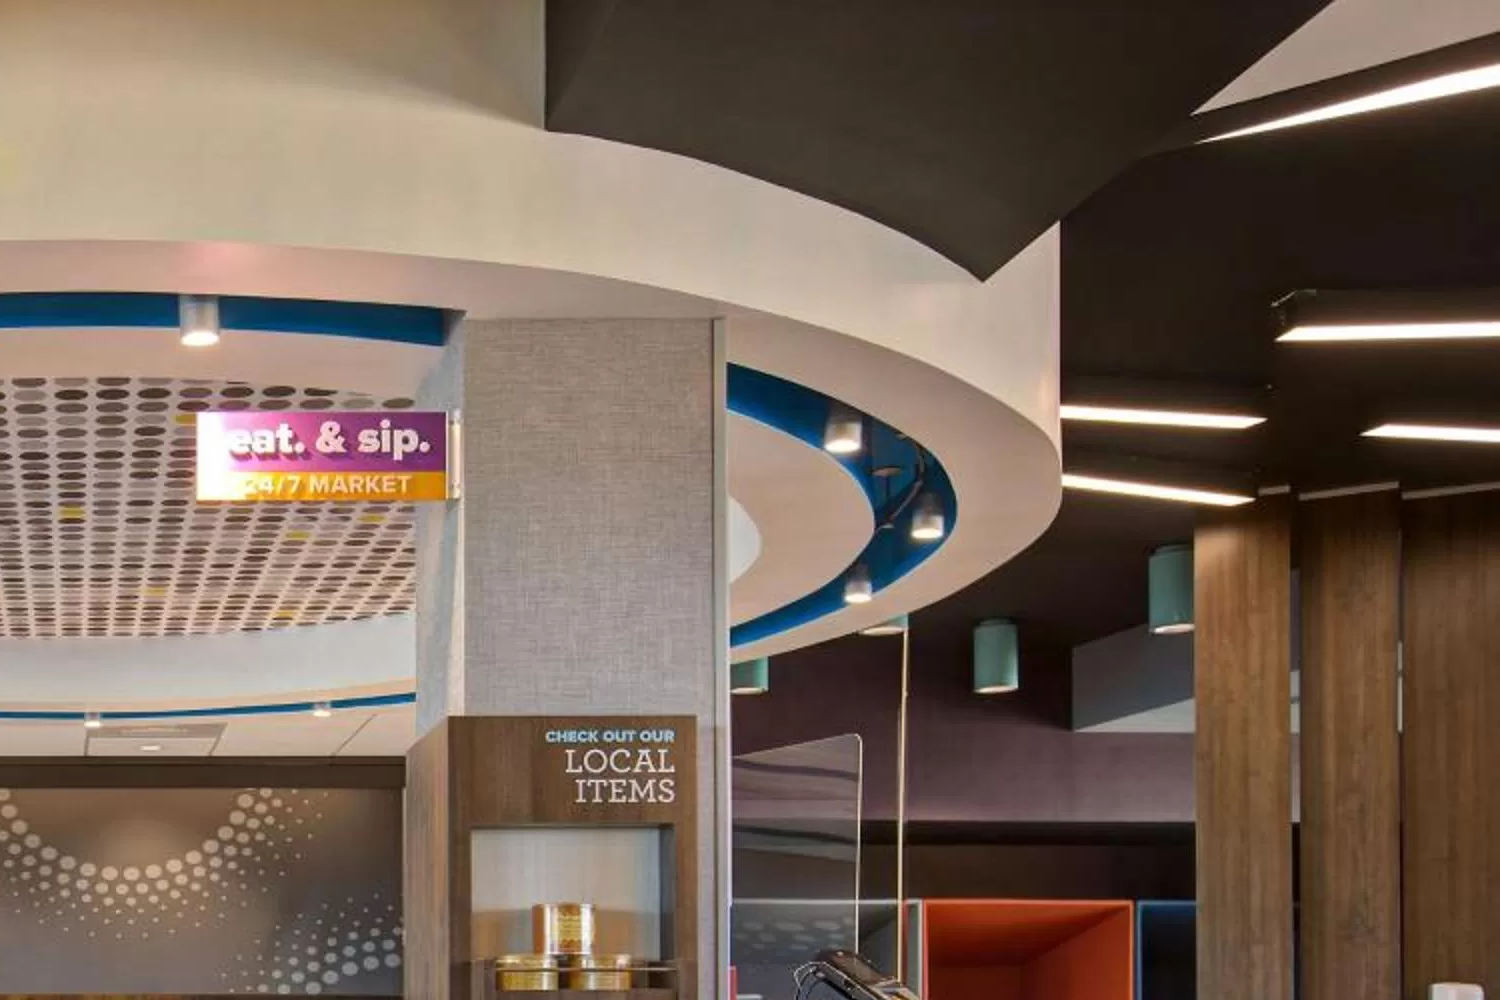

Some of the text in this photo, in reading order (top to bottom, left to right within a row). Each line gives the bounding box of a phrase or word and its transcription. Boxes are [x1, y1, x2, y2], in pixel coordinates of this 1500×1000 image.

[228, 419, 431, 460] eat. & sip.
[309, 474, 413, 495] MARKET
[545, 730, 675, 743] CHECK OUT OUR
[565, 749, 676, 773] LOCAL
[575, 779, 676, 803] ITEMS
